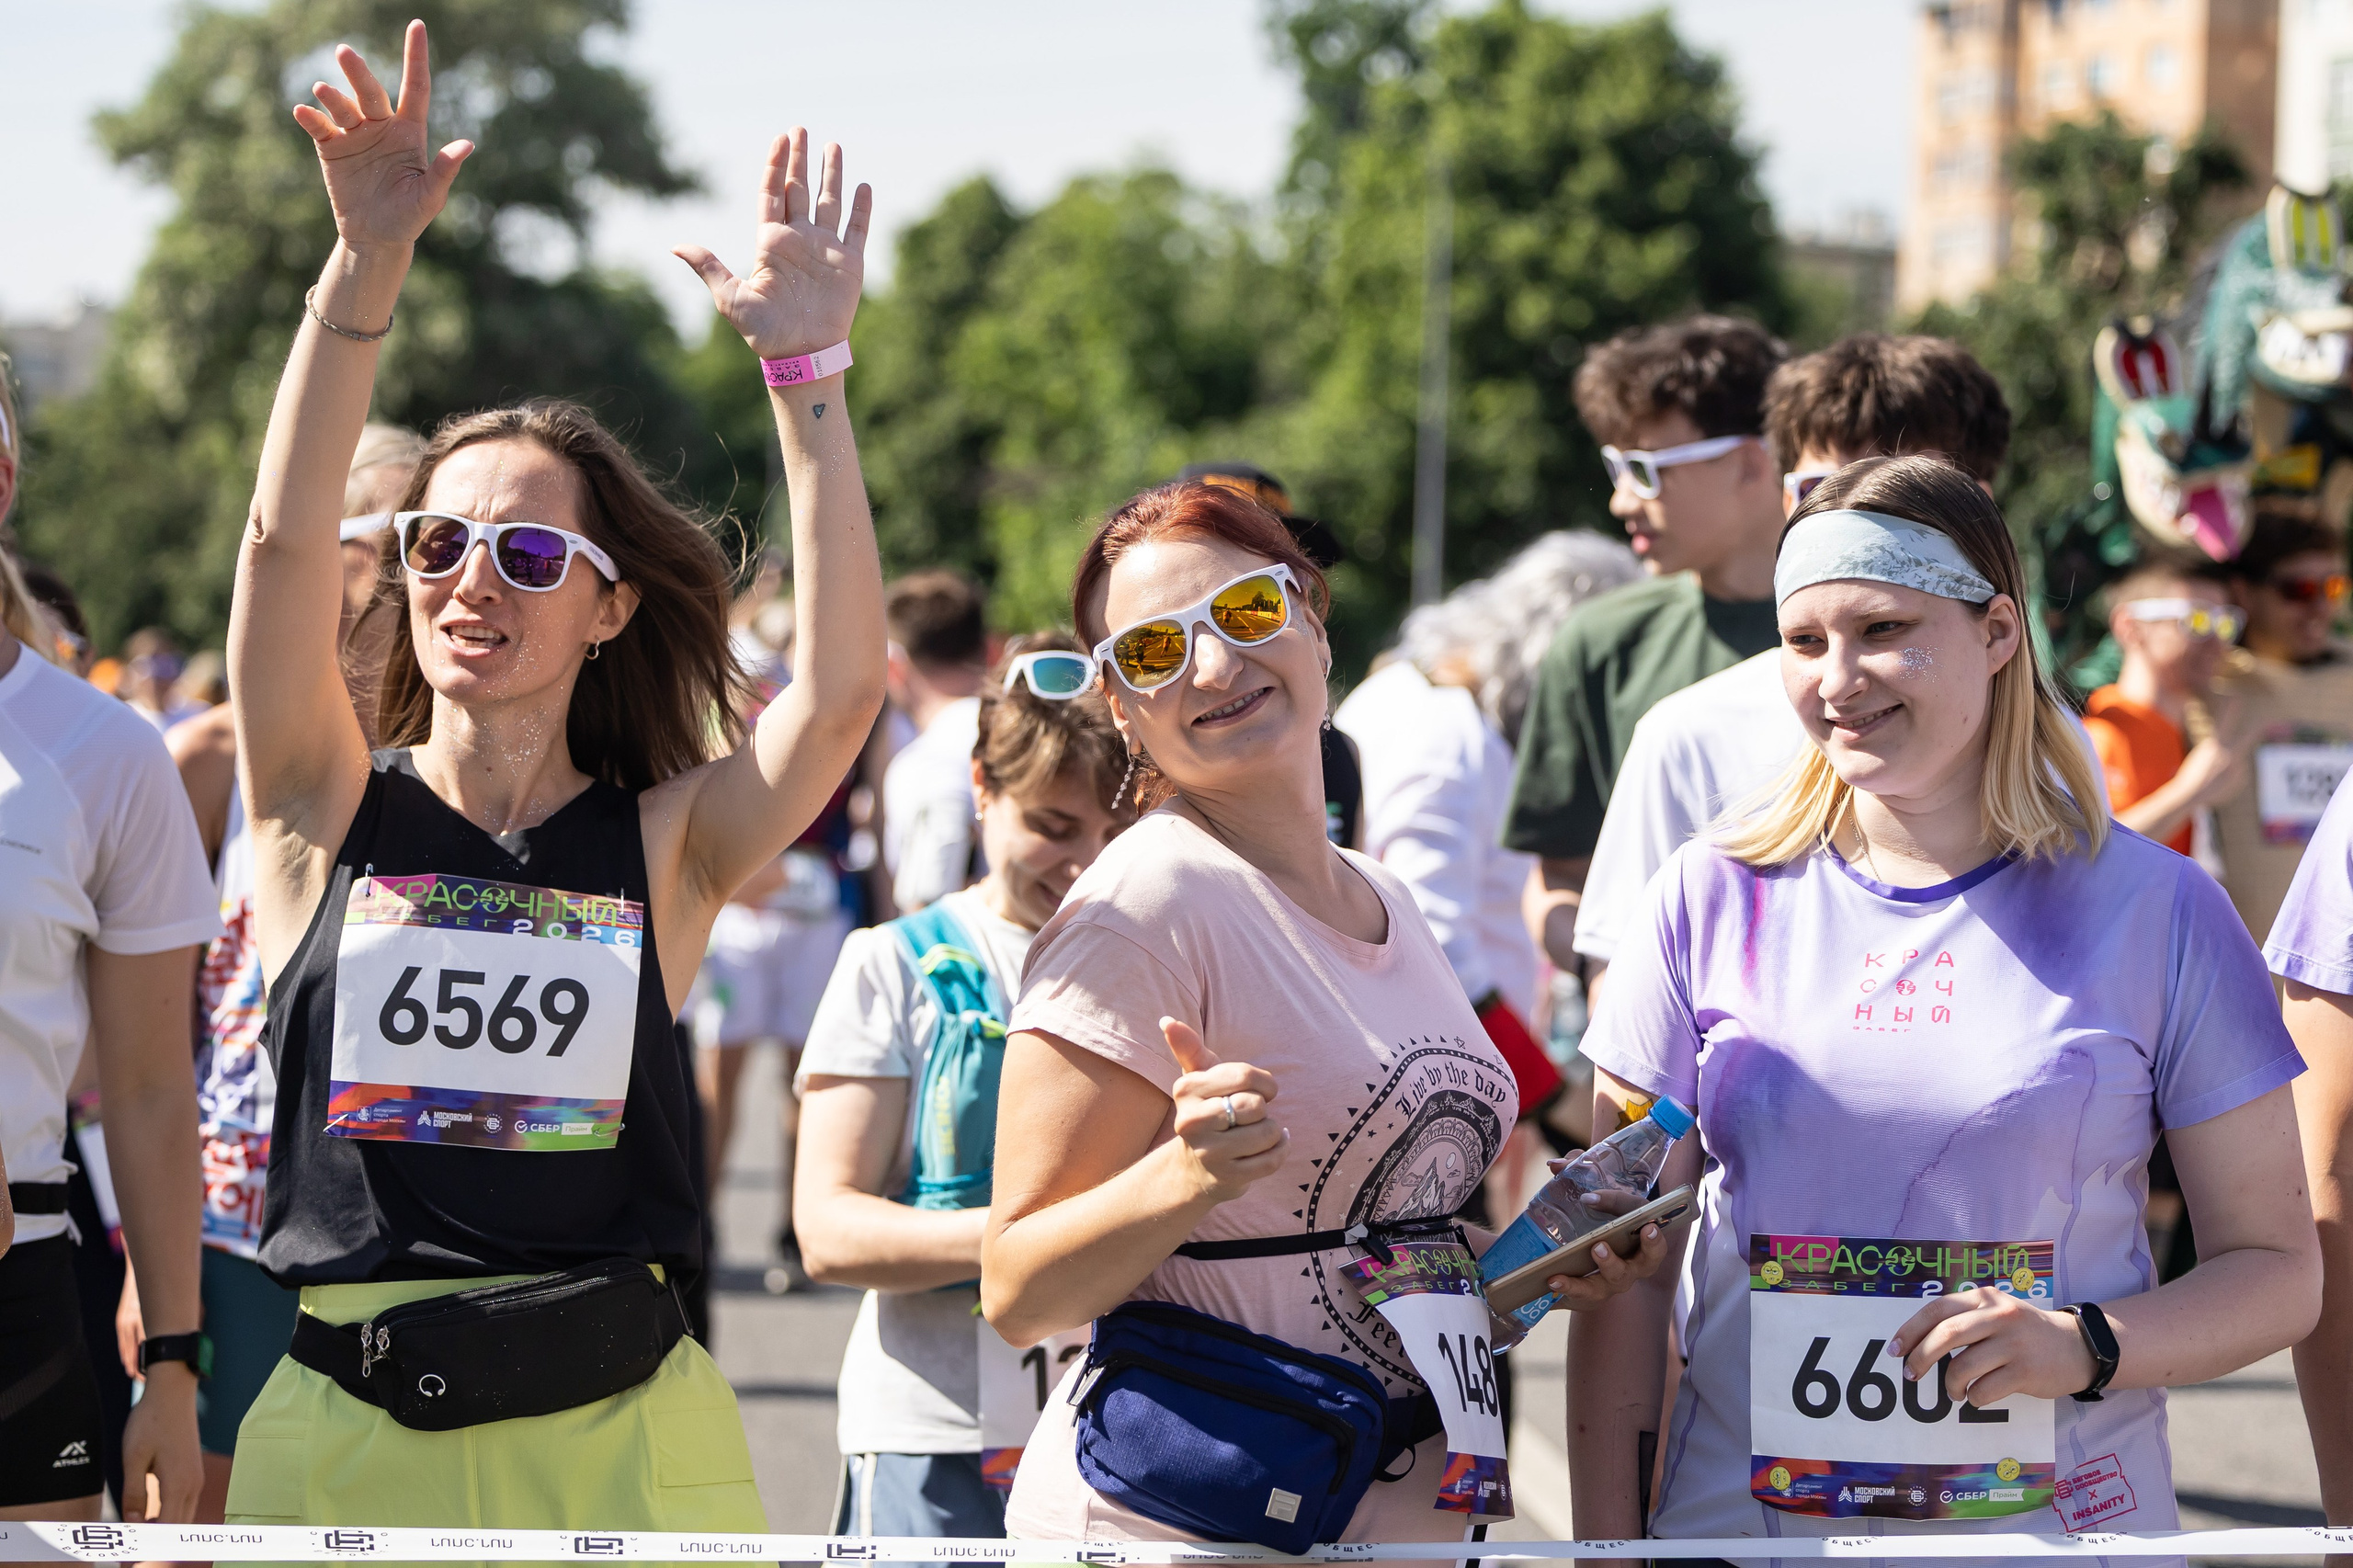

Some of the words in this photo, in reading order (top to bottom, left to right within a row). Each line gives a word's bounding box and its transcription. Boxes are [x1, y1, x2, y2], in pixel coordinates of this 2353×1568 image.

[374, 881, 619, 927] КРАСОЧНЫЙ
[512, 918, 636, 948] 2026
[379, 966, 590, 1058] 6569
[1394, 1075, 1427, 1122] Live
[1423, 1064, 1443, 1090] by
[1444, 1061, 1469, 1089] the
[1473, 1068, 1506, 1108] day
[433, 1110, 473, 1123] МОСКОВСКИЙ
[432, 1120, 451, 1129] СПОРТ
[529, 1123, 561, 1133] СБЕР
[1776, 1242, 2029, 1278] КРАСОЧНЫЙ
[1390, 1280, 1455, 1292] ЗАБЕГ
[1778, 1278, 1906, 1292] ЗАБЕГ
[1437, 1332, 1498, 1418] 148
[1854, 1485, 1895, 1496] МОСКОВСКИЙ
[1956, 1491, 1987, 1501] СБЕР
[1993, 1491, 2018, 1499] Прайм
[1854, 1494, 1874, 1504] СПОРТ
[2072, 1493, 2125, 1521] INSANITY
